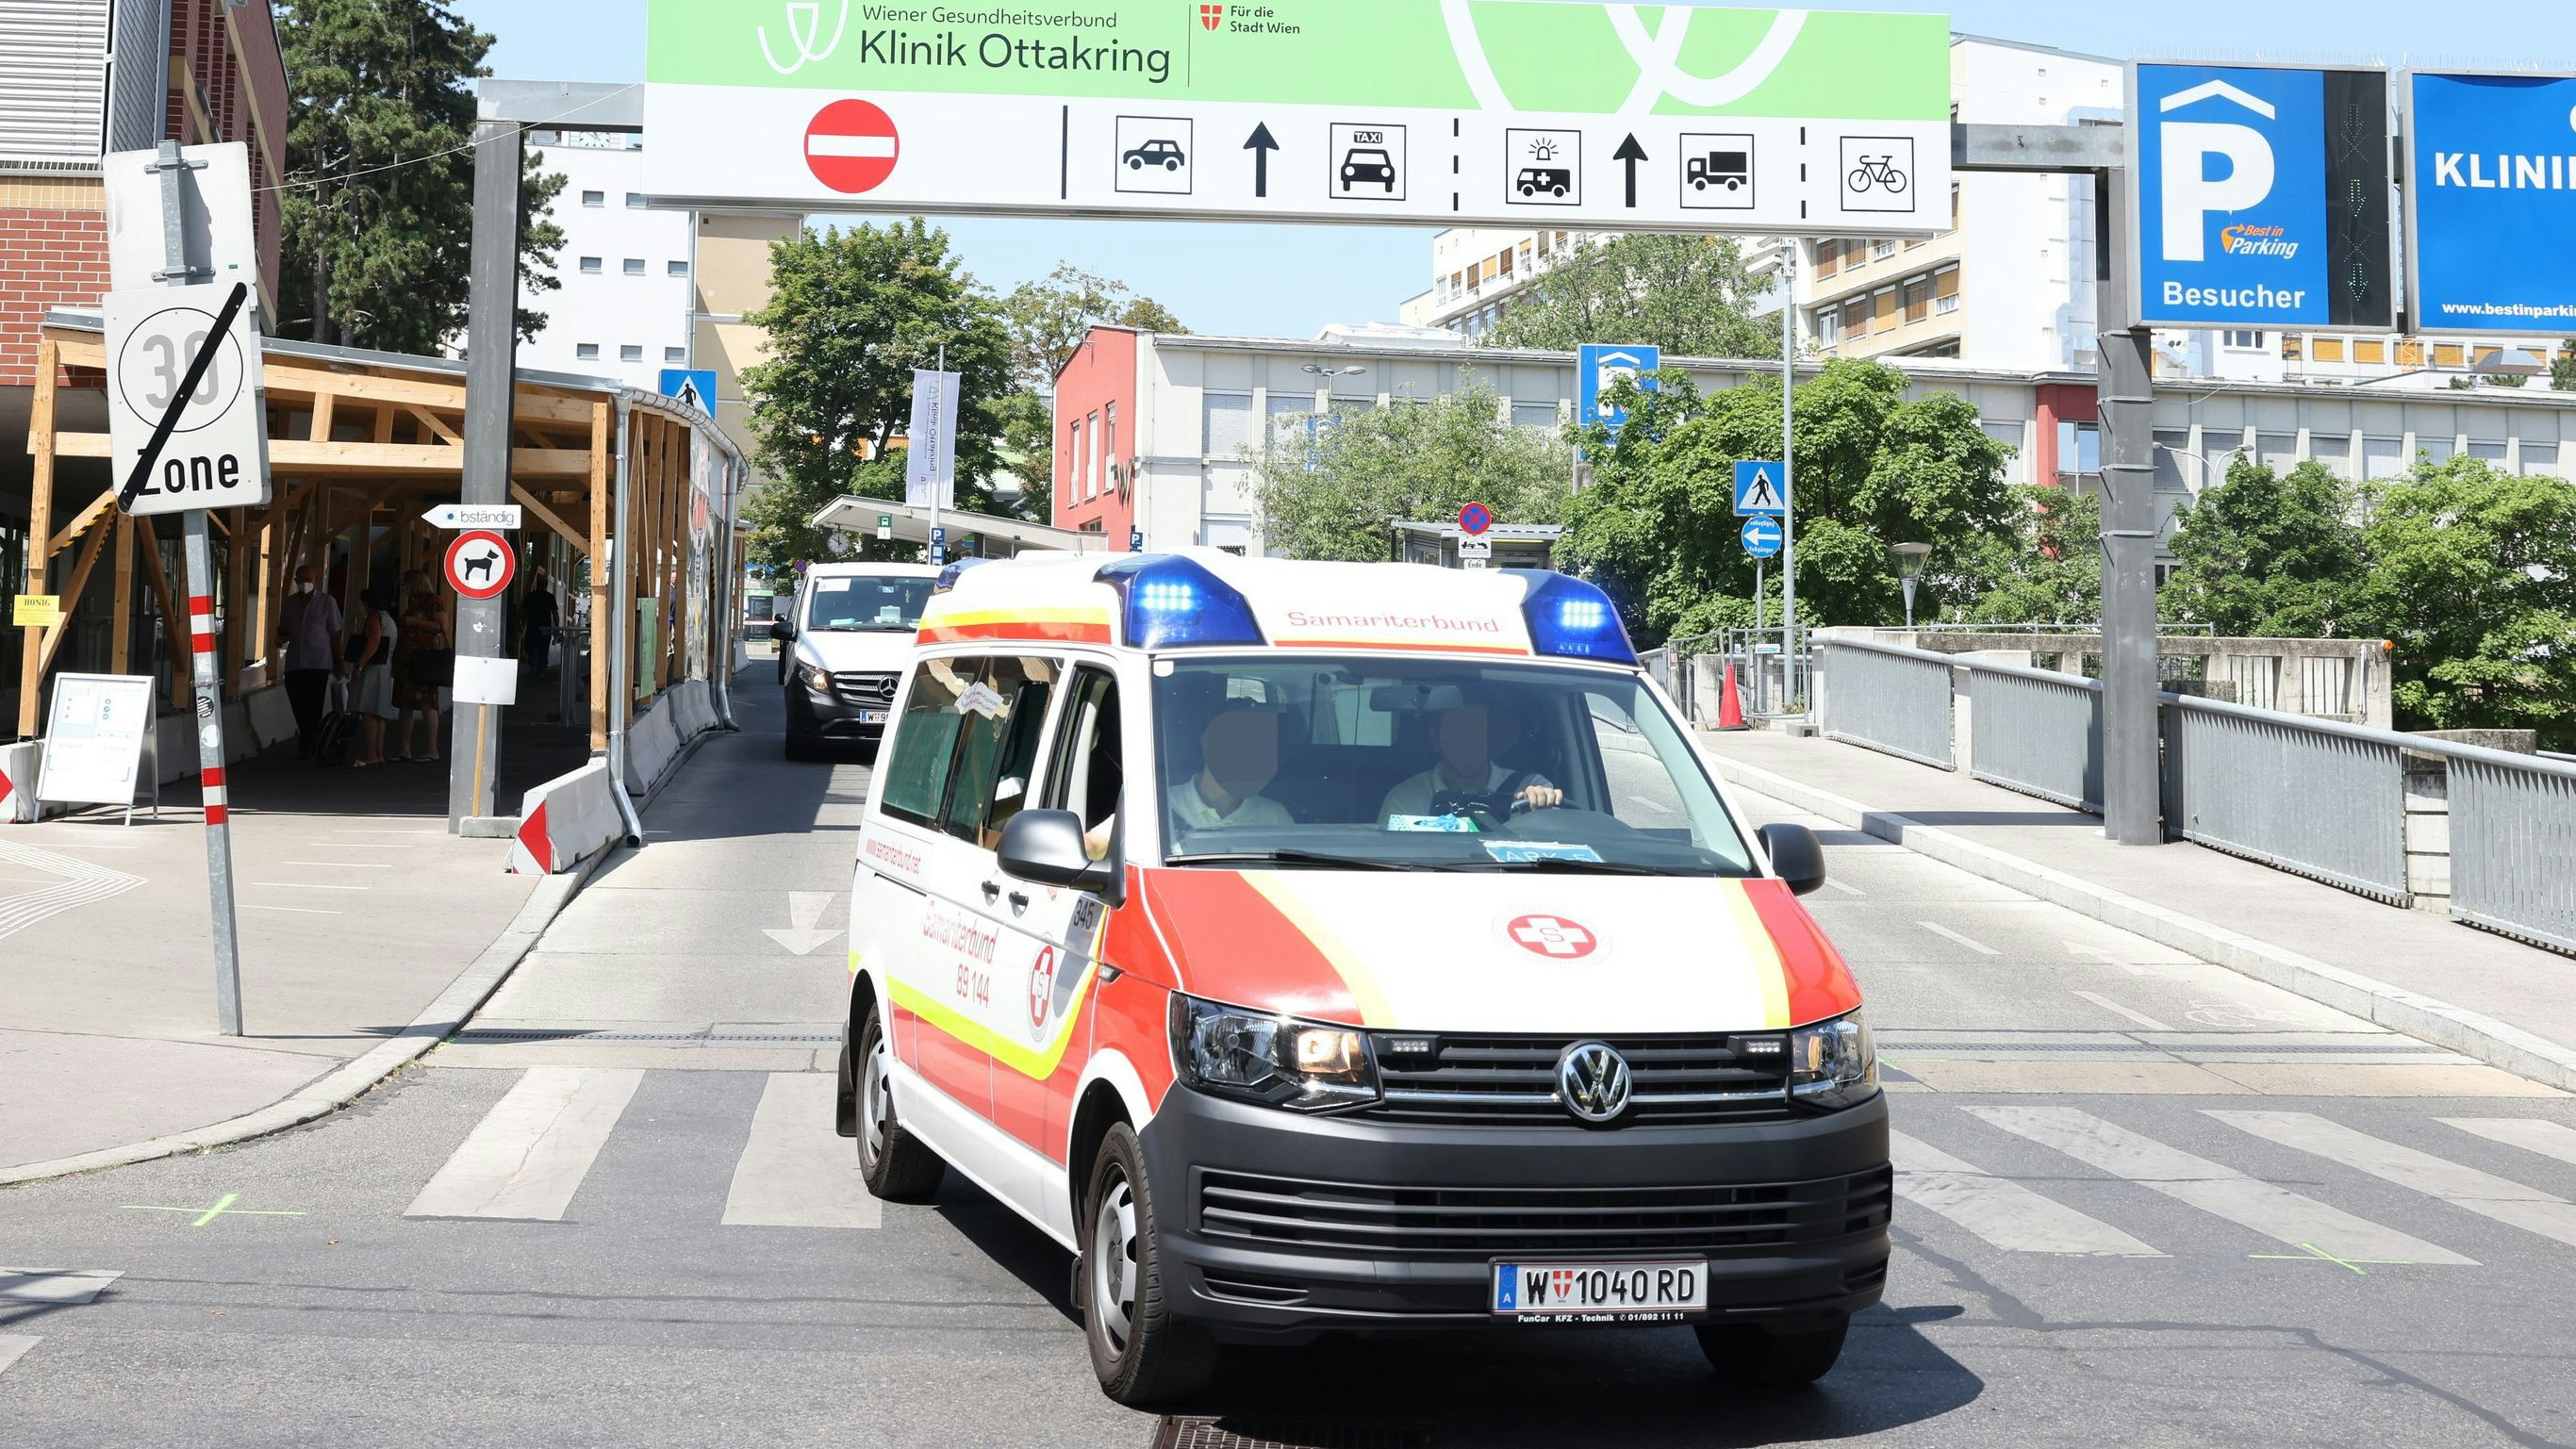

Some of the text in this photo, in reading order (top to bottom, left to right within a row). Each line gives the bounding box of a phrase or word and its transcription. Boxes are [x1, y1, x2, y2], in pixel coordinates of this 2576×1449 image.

[863, 5, 1117, 28] Wiener Gesundheitsverbund
[1230, 5, 1274, 18] Für die
[1230, 21, 1300, 34] Stadt Wien
[861, 29, 1170, 84] Klinik Ottakring
[1354, 132, 1381, 142] TAXI
[2435, 152, 2576, 189] KLINI
[2160, 122, 2275, 262] P
[2244, 224, 2284, 237] Best in
[2228, 237, 2299, 259] Parking
[2163, 281, 2305, 308] Besucher
[2442, 303, 2576, 319] www.bestinparki
[141, 330, 220, 409] 30
[137, 448, 239, 497] Zone
[1287, 612, 1500, 633] Samariterbund
[1073, 898, 1096, 930] 345
[923, 900, 999, 965] Samariterbund
[956, 963, 990, 1010] 89 144
[1502, 1293, 1511, 1304] A
[1526, 1269, 1694, 1305] W 1040 RD
[1518, 1314, 1550, 1323] FunCar
[1555, 1314, 1573, 1323] KFZ
